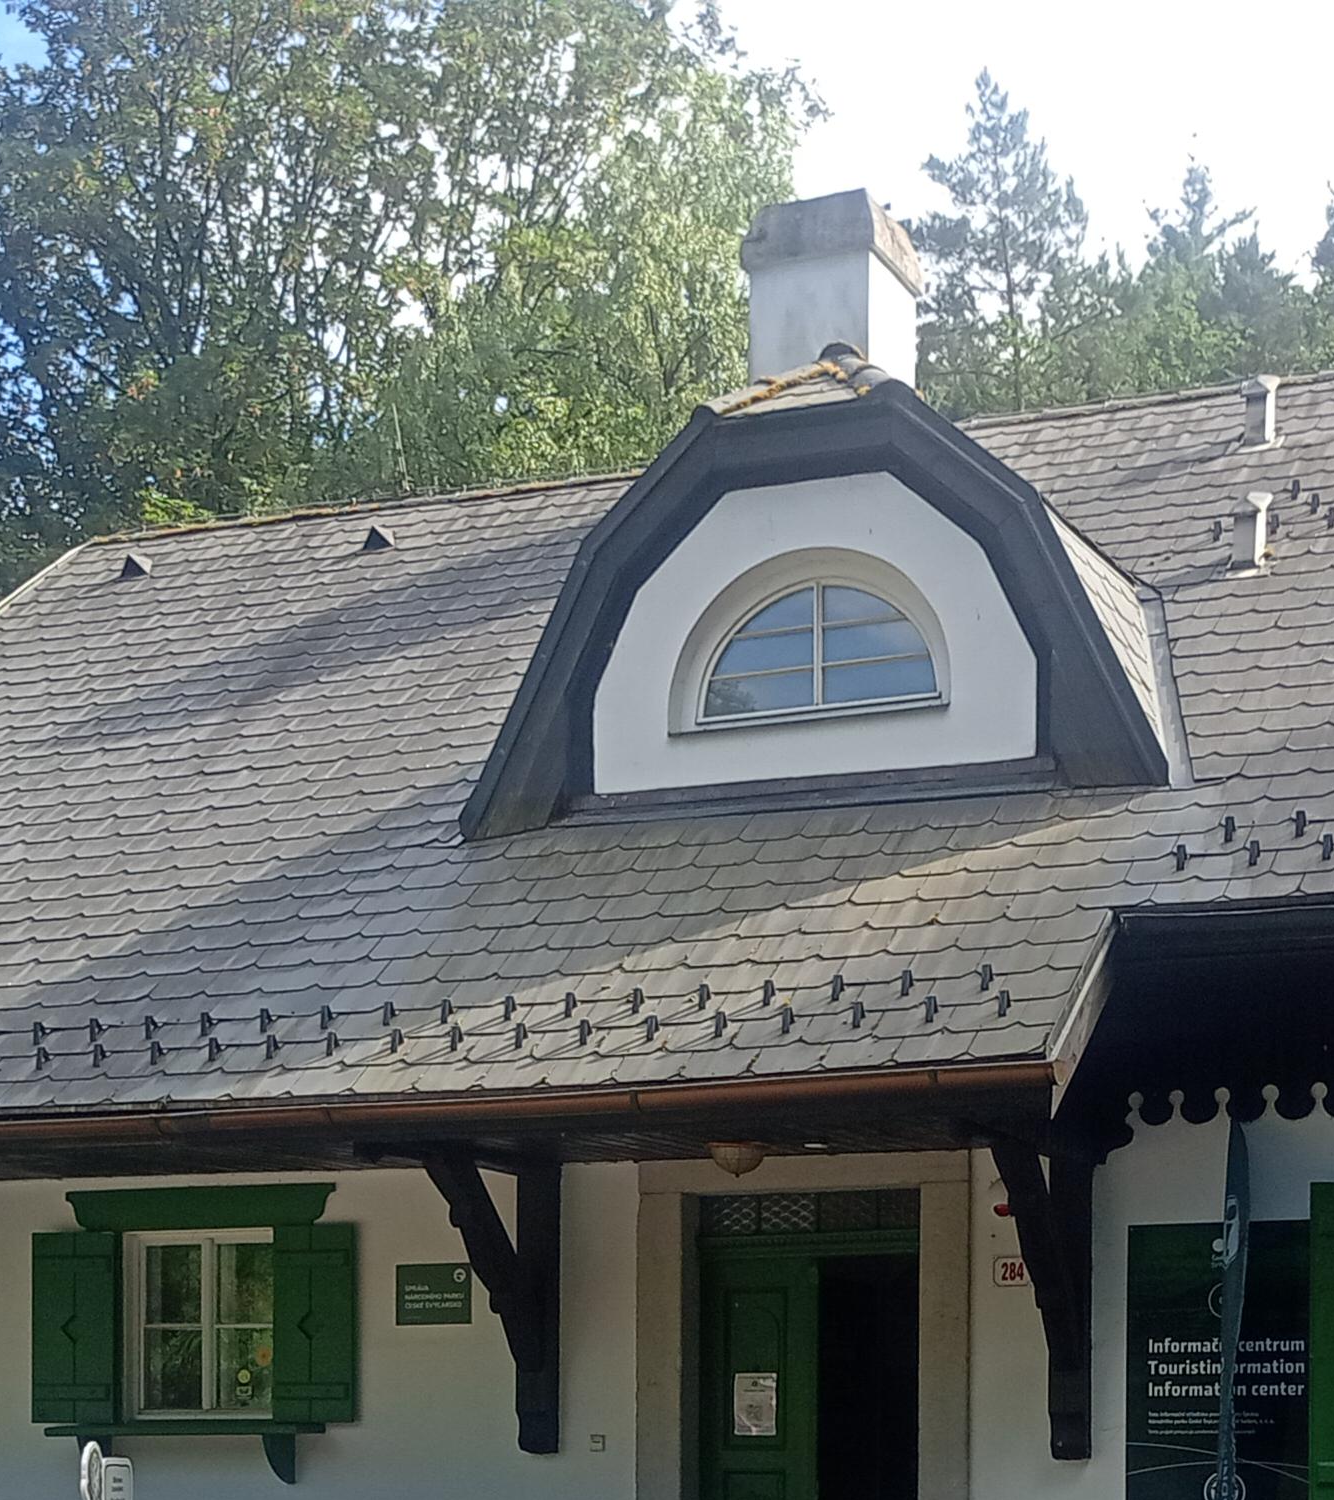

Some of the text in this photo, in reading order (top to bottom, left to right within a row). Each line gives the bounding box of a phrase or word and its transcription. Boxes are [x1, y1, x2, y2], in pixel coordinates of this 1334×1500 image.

[1001, 1262, 1024, 1281] 284
[1148, 1337, 1306, 1354] Informač centrum
[1147, 1358, 1306, 1376] Touristinormation
[1148, 1380, 1305, 1398] Informatn center
